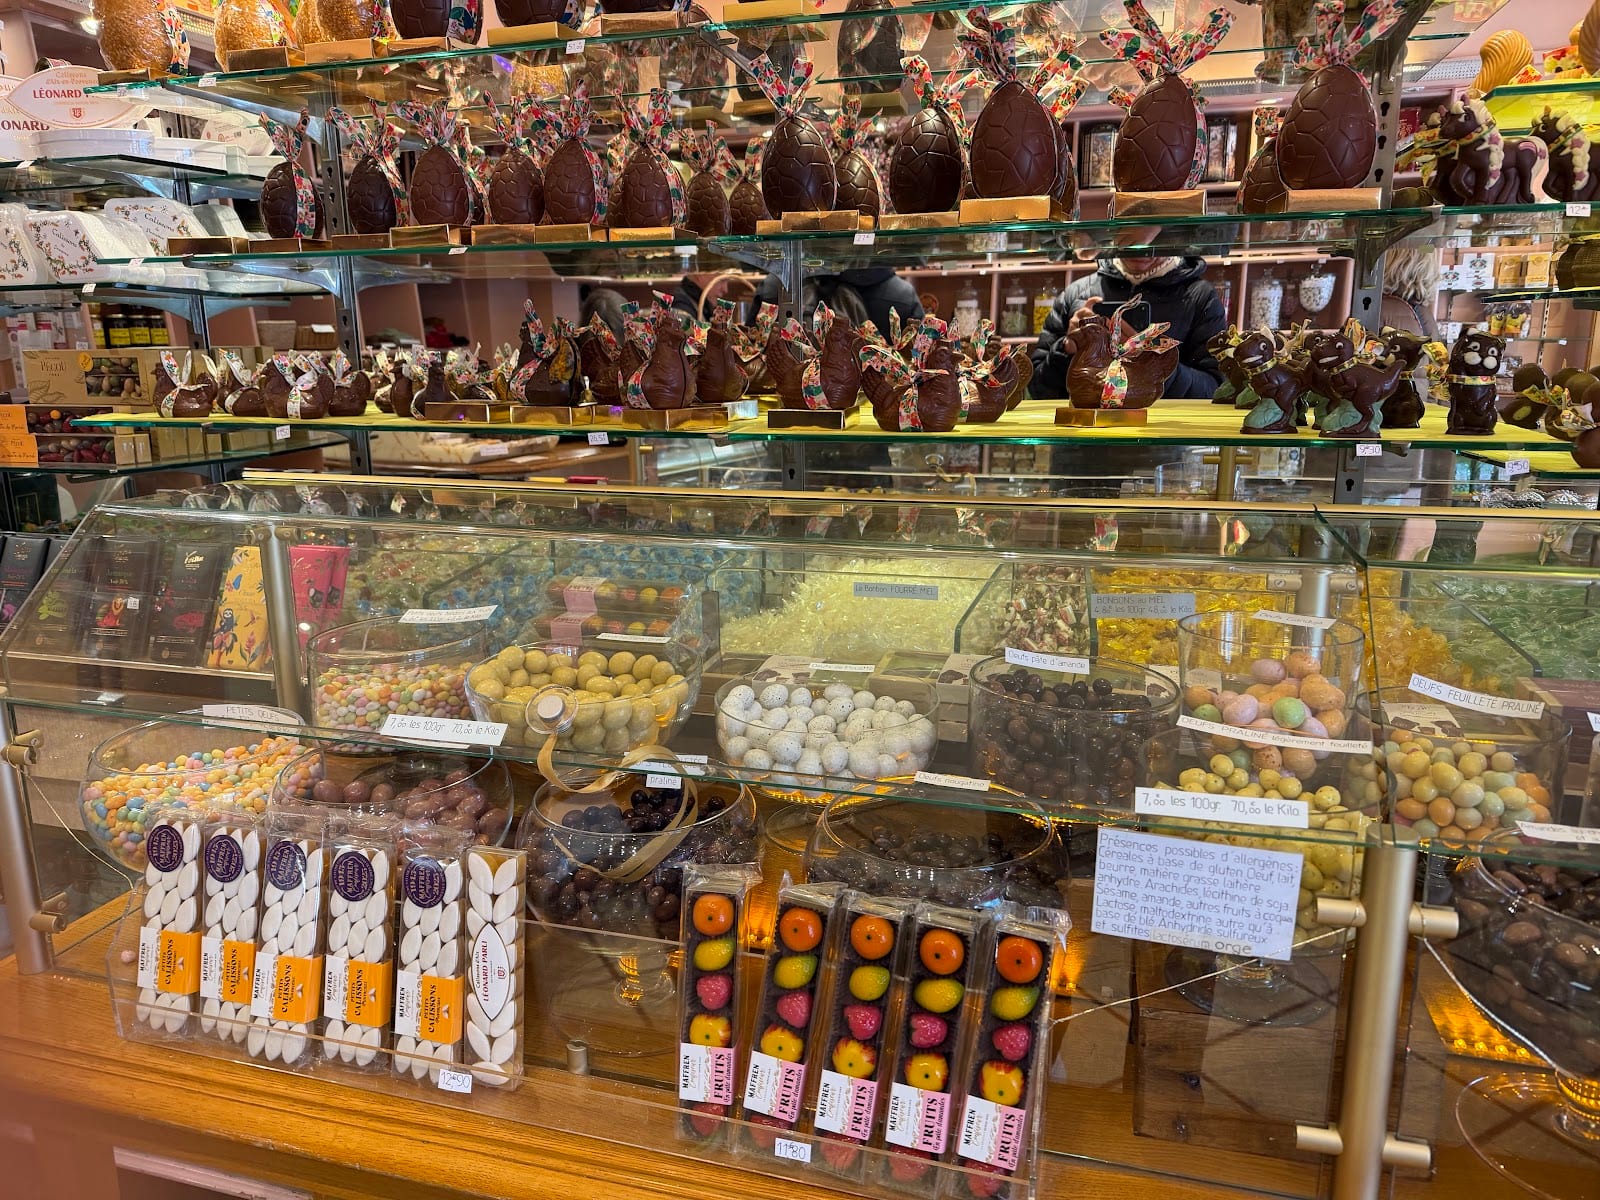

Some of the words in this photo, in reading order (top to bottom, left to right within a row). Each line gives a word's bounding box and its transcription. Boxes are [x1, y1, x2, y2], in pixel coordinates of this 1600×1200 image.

[33, 87, 82, 99] LÉONARD
[1148, 595, 1166, 604] MIEL
[1031, 654, 1048, 665] pâte
[226, 705, 254, 717] PETITS
[1447, 688, 1498, 709] FEUILLETÉ
[1501, 700, 1542, 714] PRALINÉ
[409, 719, 421, 729] les
[475, 725, 484, 735] le
[485, 725, 500, 736] Kilo
[1221, 723, 1266, 742] PRALINÉ
[1170, 795, 1186, 807] les
[1264, 803, 1275, 815] le
[1277, 803, 1300, 817] Kilo
[1100, 832, 1159, 854] Présences
[1164, 844, 1216, 861] possibles
[1147, 853, 1154, 865] à
[1157, 856, 1185, 869] base
[1189, 860, 1203, 871] de
[1140, 866, 1180, 881] matière
[1182, 872, 1220, 887] grasse
[1223, 876, 1261, 894] laitière
[1185, 900, 1221, 914] autres
[1223, 903, 1252, 918] fruits
[1254, 908, 1261, 920] à
[1203, 886, 1248, 903] lécithine
[1250, 895, 1264, 907] de
[1095, 919, 1105, 930] et
[1095, 907, 1121, 920] base
[1123, 912, 1136, 924] de
[1158, 917, 1213, 936] Anhydride
[1216, 927, 1269, 944] sulfureux
[1140, 904, 1212, 924] maltodextrine
[1216, 918, 1244, 930] autre
[139, 942, 147, 971] MAFFREN
[165, 938, 175, 985] CALISSONS
[480, 940, 489, 962] PARLI
[229, 948, 238, 995] CALISSONS
[253, 968, 262, 999] MAFFREN
[481, 965, 490, 1002] LÉONARD
[277, 977, 285, 999] PETITS
[281, 964, 292, 1013] CALISSONS
[354, 968, 363, 1016] CALISSONS
[398, 986, 406, 1018] MAFFREN
[427, 984, 437, 1033] CALISSONS
[682, 1054, 690, 1089] MAFFREN
[713, 1052, 726, 1099] FRUITS
[748, 1063, 760, 1099] MAFFREN
[778, 1067, 795, 1114] FRUITS
[819, 1082, 831, 1118] MAFFREN
[851, 1085, 868, 1133] FRUITS
[889, 1095, 900, 1131] MAFFREN
[922, 1097, 938, 1146] FRUITS
[963, 1109, 977, 1146] MAFFREN
[997, 1113, 1016, 1162] FRUITS
